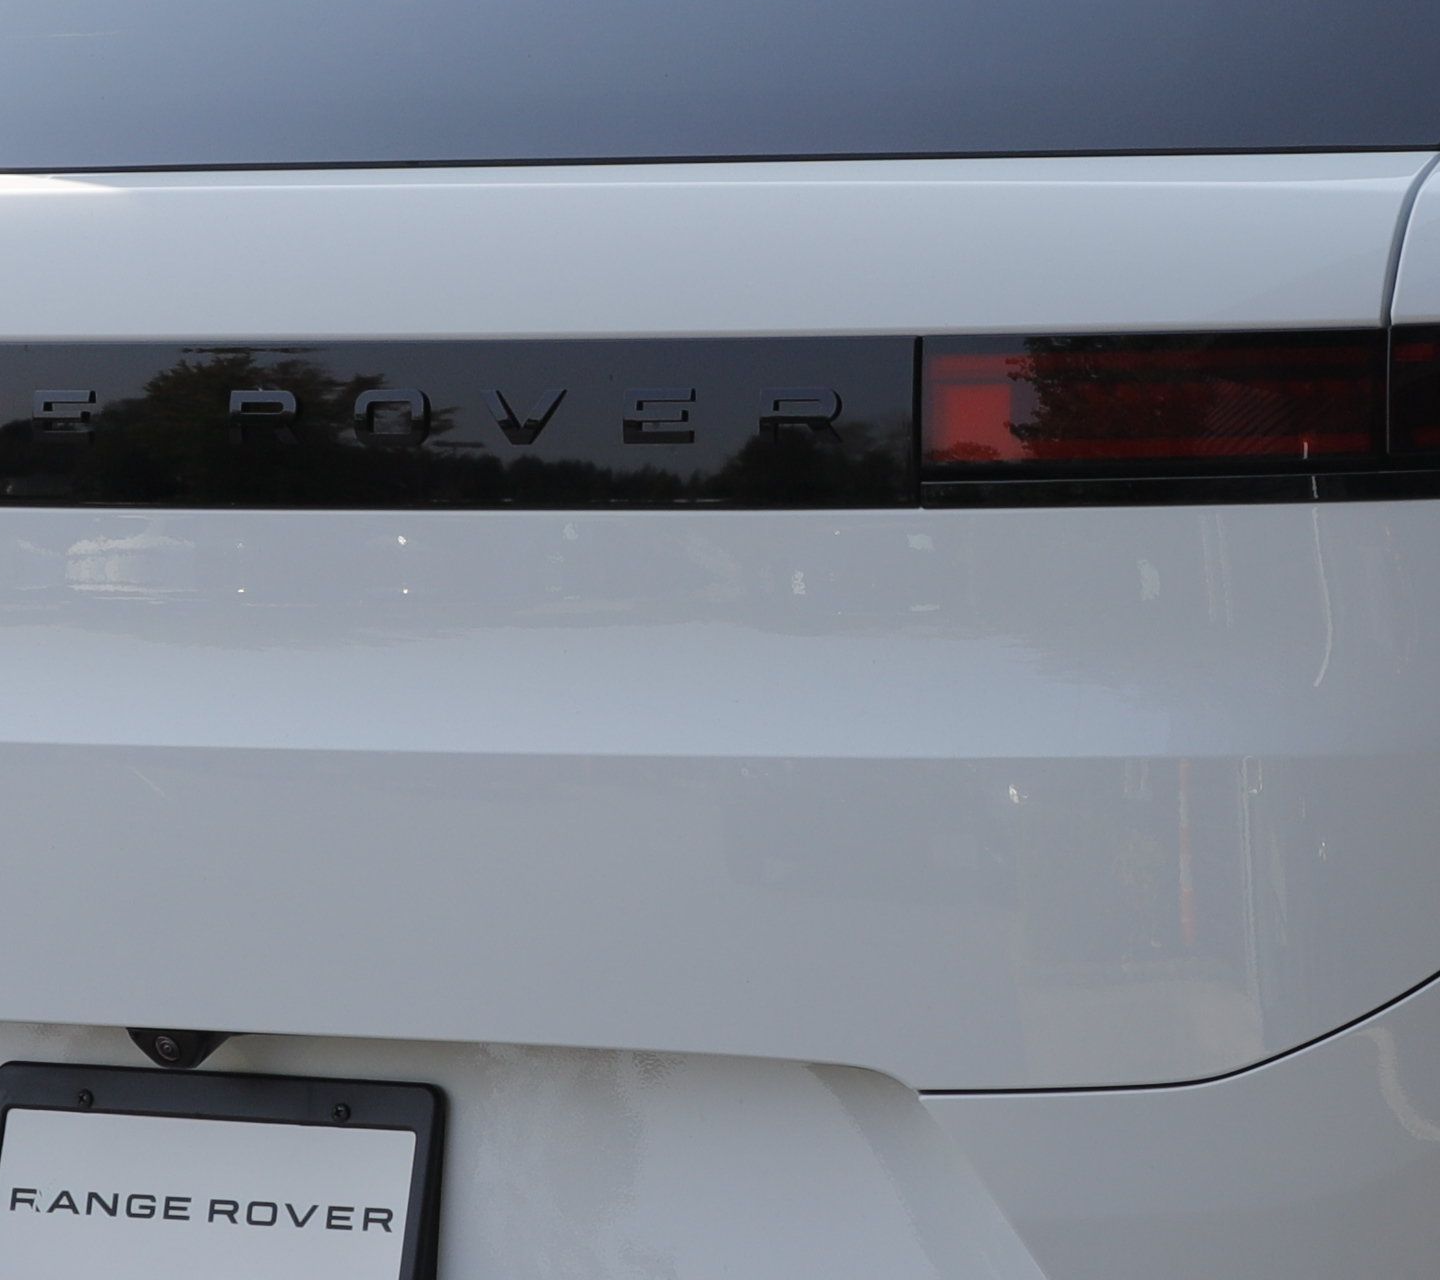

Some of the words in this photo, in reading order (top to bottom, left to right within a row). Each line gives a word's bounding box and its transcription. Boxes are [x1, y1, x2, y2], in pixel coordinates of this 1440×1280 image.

[229, 387, 843, 446] ROVER
[9, 1187, 192, 1221] RANGE
[207, 1198, 394, 1234] ROVER
